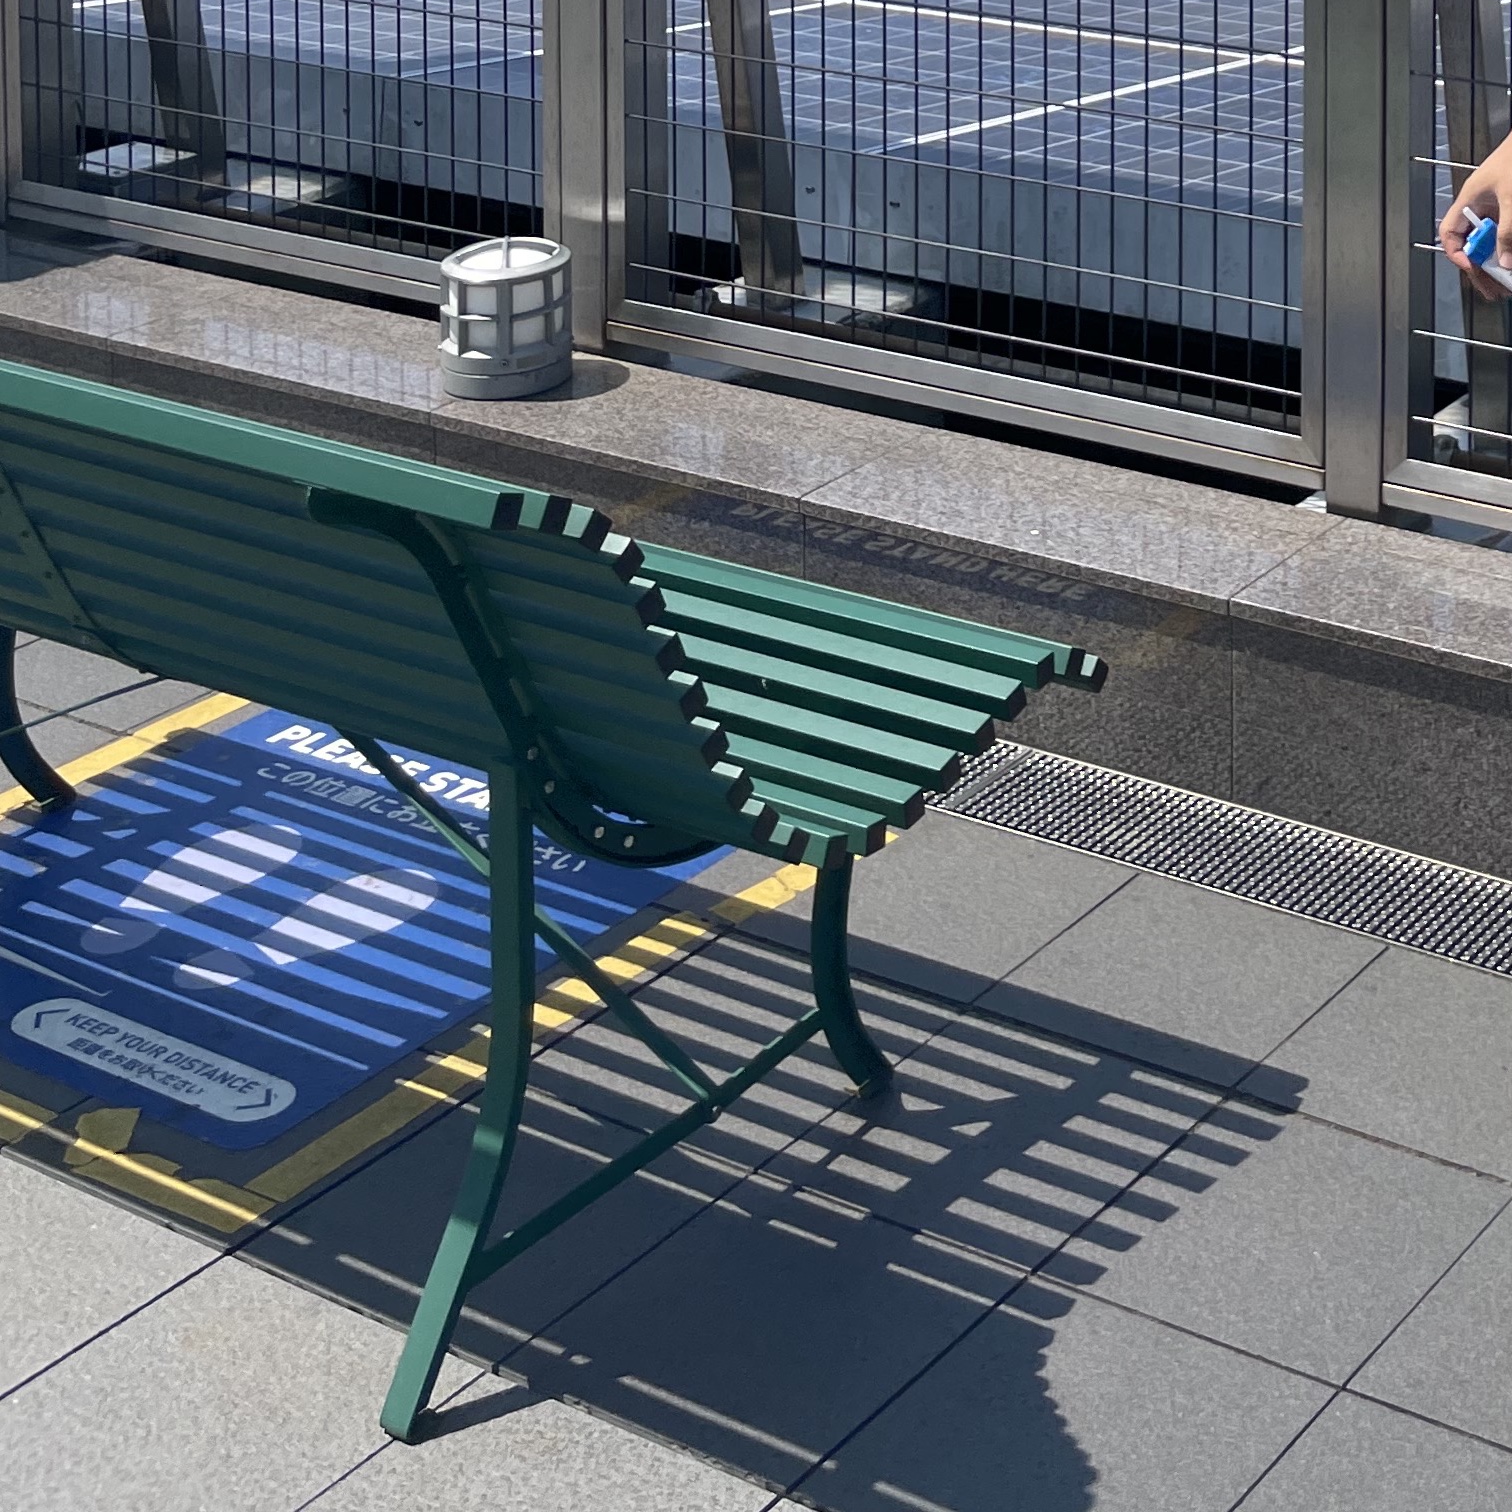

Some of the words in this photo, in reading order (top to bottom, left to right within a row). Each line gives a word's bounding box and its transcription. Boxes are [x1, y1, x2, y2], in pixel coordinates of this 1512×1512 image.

[419, 771, 491, 812] STA
[64, 1012, 120, 1038] KEEP
[115, 1031, 167, 1059] YOUR
[162, 1050, 262, 1095] DISTANCE
